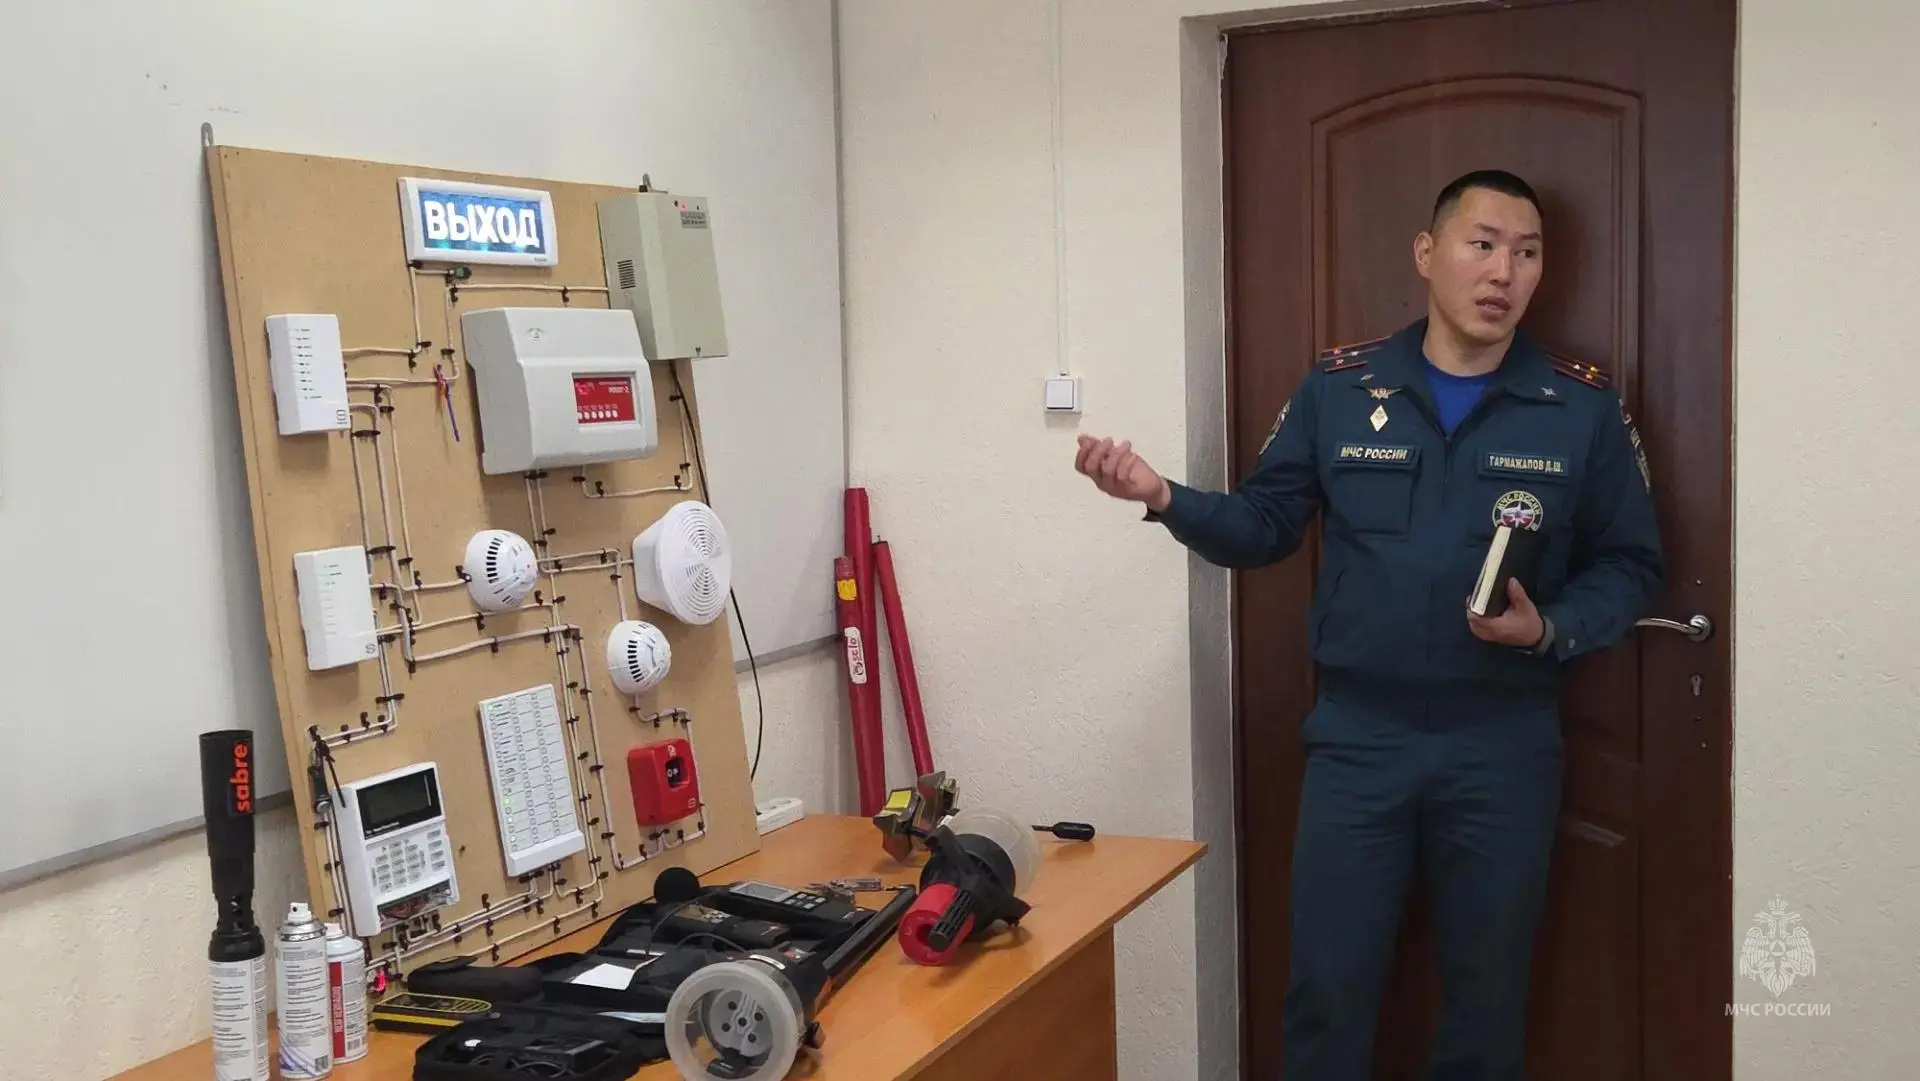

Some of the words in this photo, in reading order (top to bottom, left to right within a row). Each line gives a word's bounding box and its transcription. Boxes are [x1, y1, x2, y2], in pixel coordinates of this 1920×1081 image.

[423, 200, 540, 248] ВЫХОД
[1340, 446, 1363, 458] МЧС
[1364, 447, 1408, 460] РОССИИ
[228, 743, 250, 812] sabre
